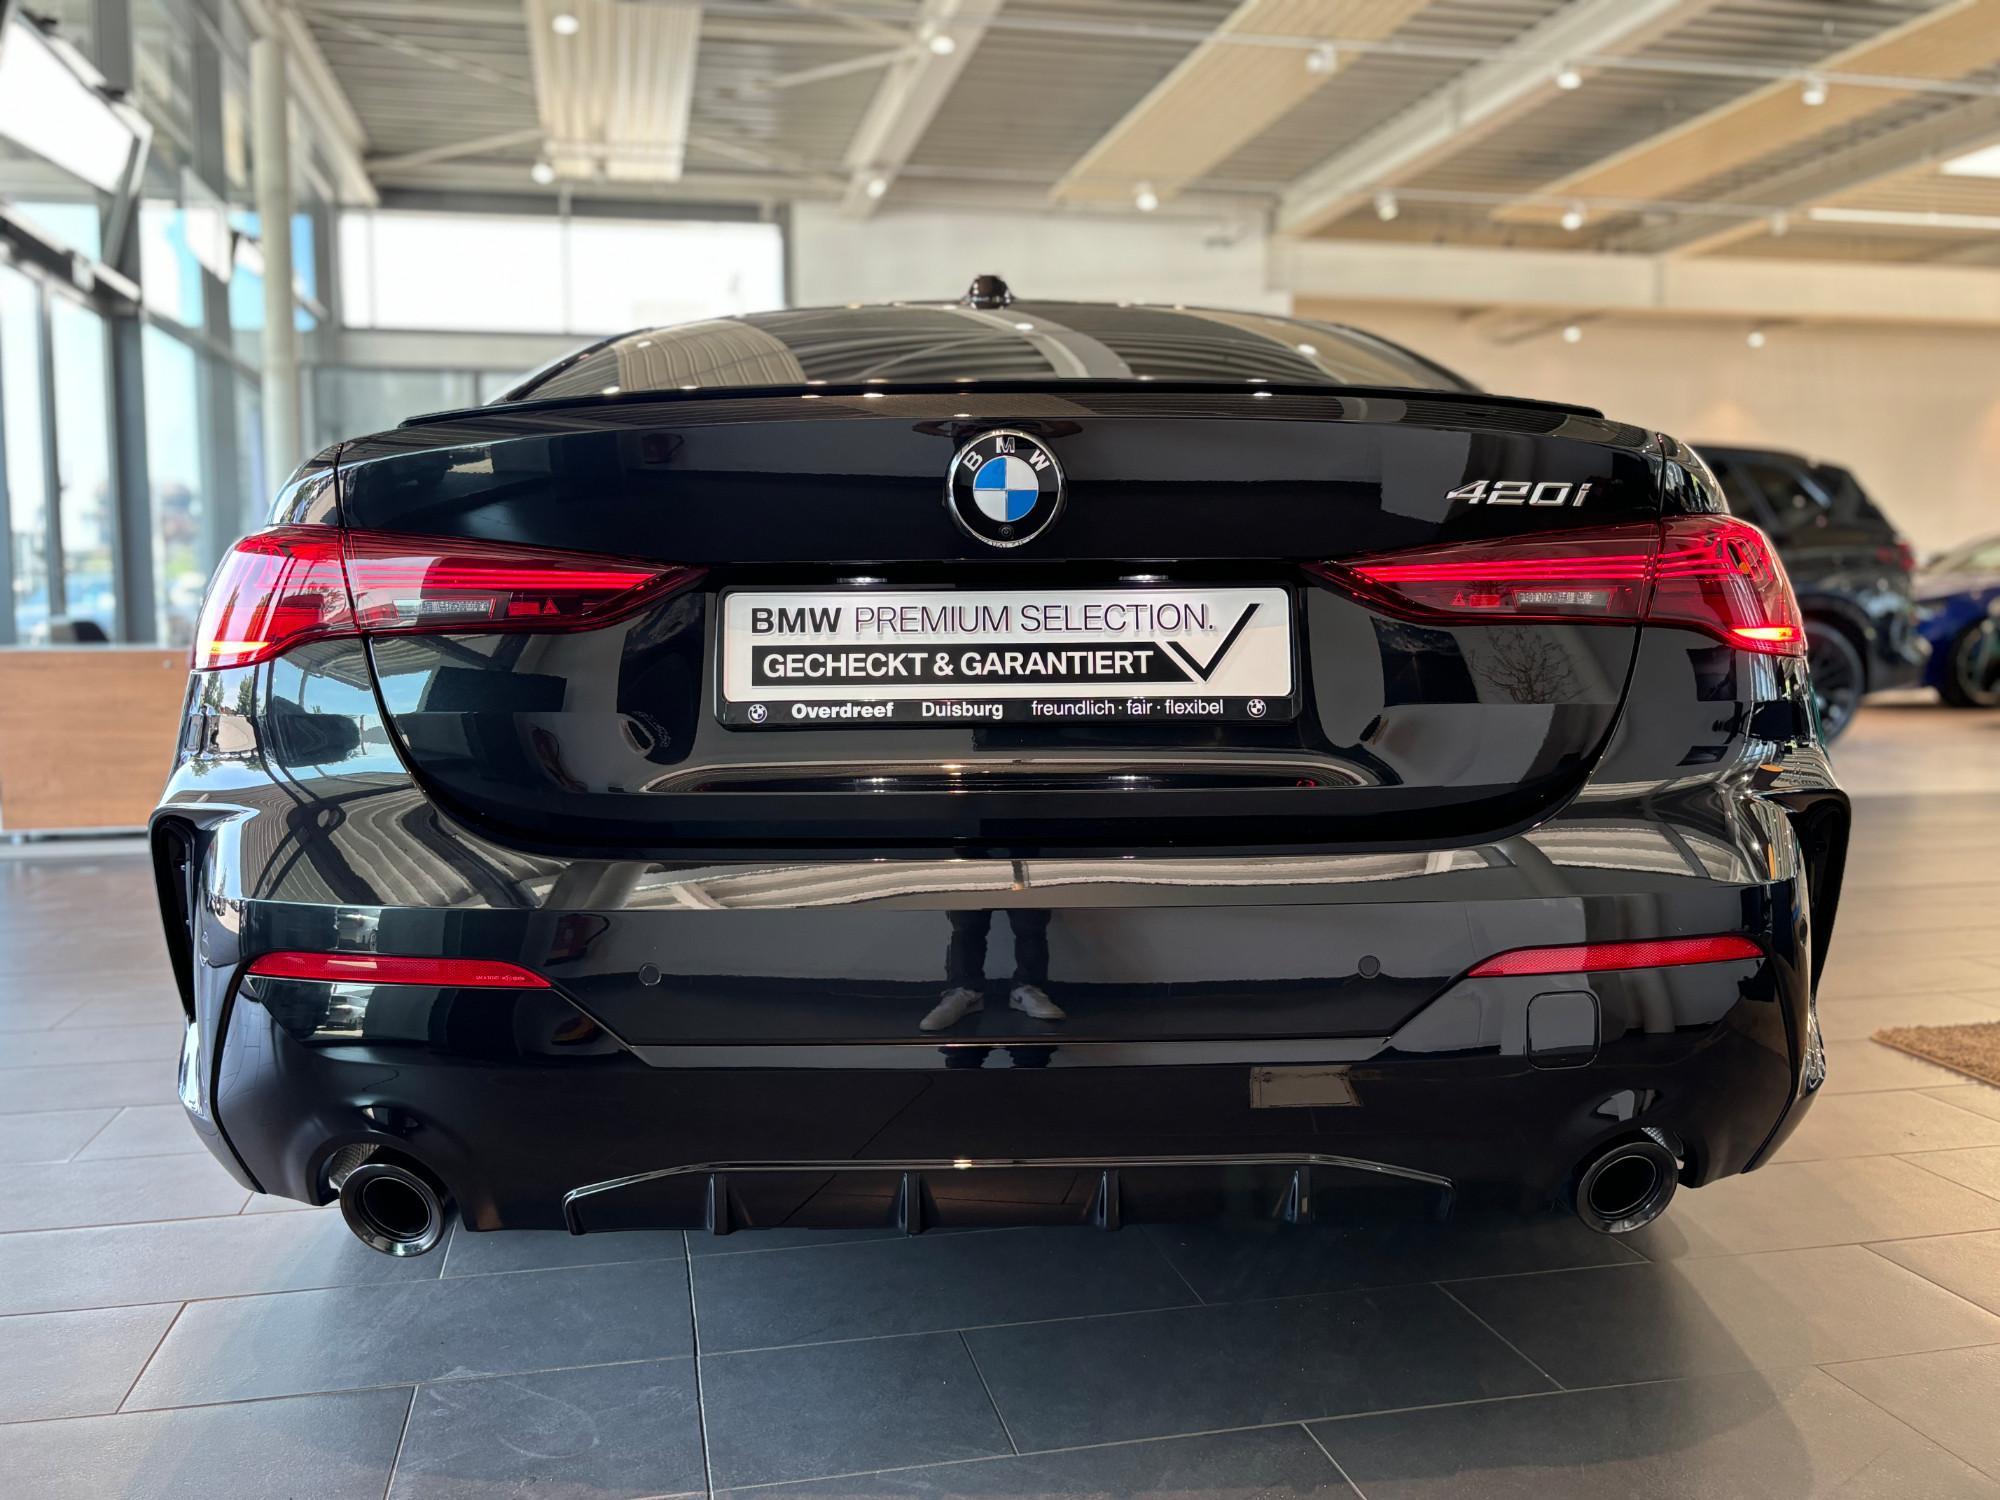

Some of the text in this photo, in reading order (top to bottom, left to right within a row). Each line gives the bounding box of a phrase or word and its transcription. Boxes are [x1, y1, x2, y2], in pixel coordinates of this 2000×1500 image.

[962, 437, 1050, 472] BMW
[1446, 480, 1593, 507] 420i
[751, 603, 1215, 634] BMW PREMIUM SELECTION.
[763, 651, 1154, 678] GECHECKT & GARANTIERT
[791, 699, 1224, 720] Overdreef Duisburg freundlich fair flexibel
